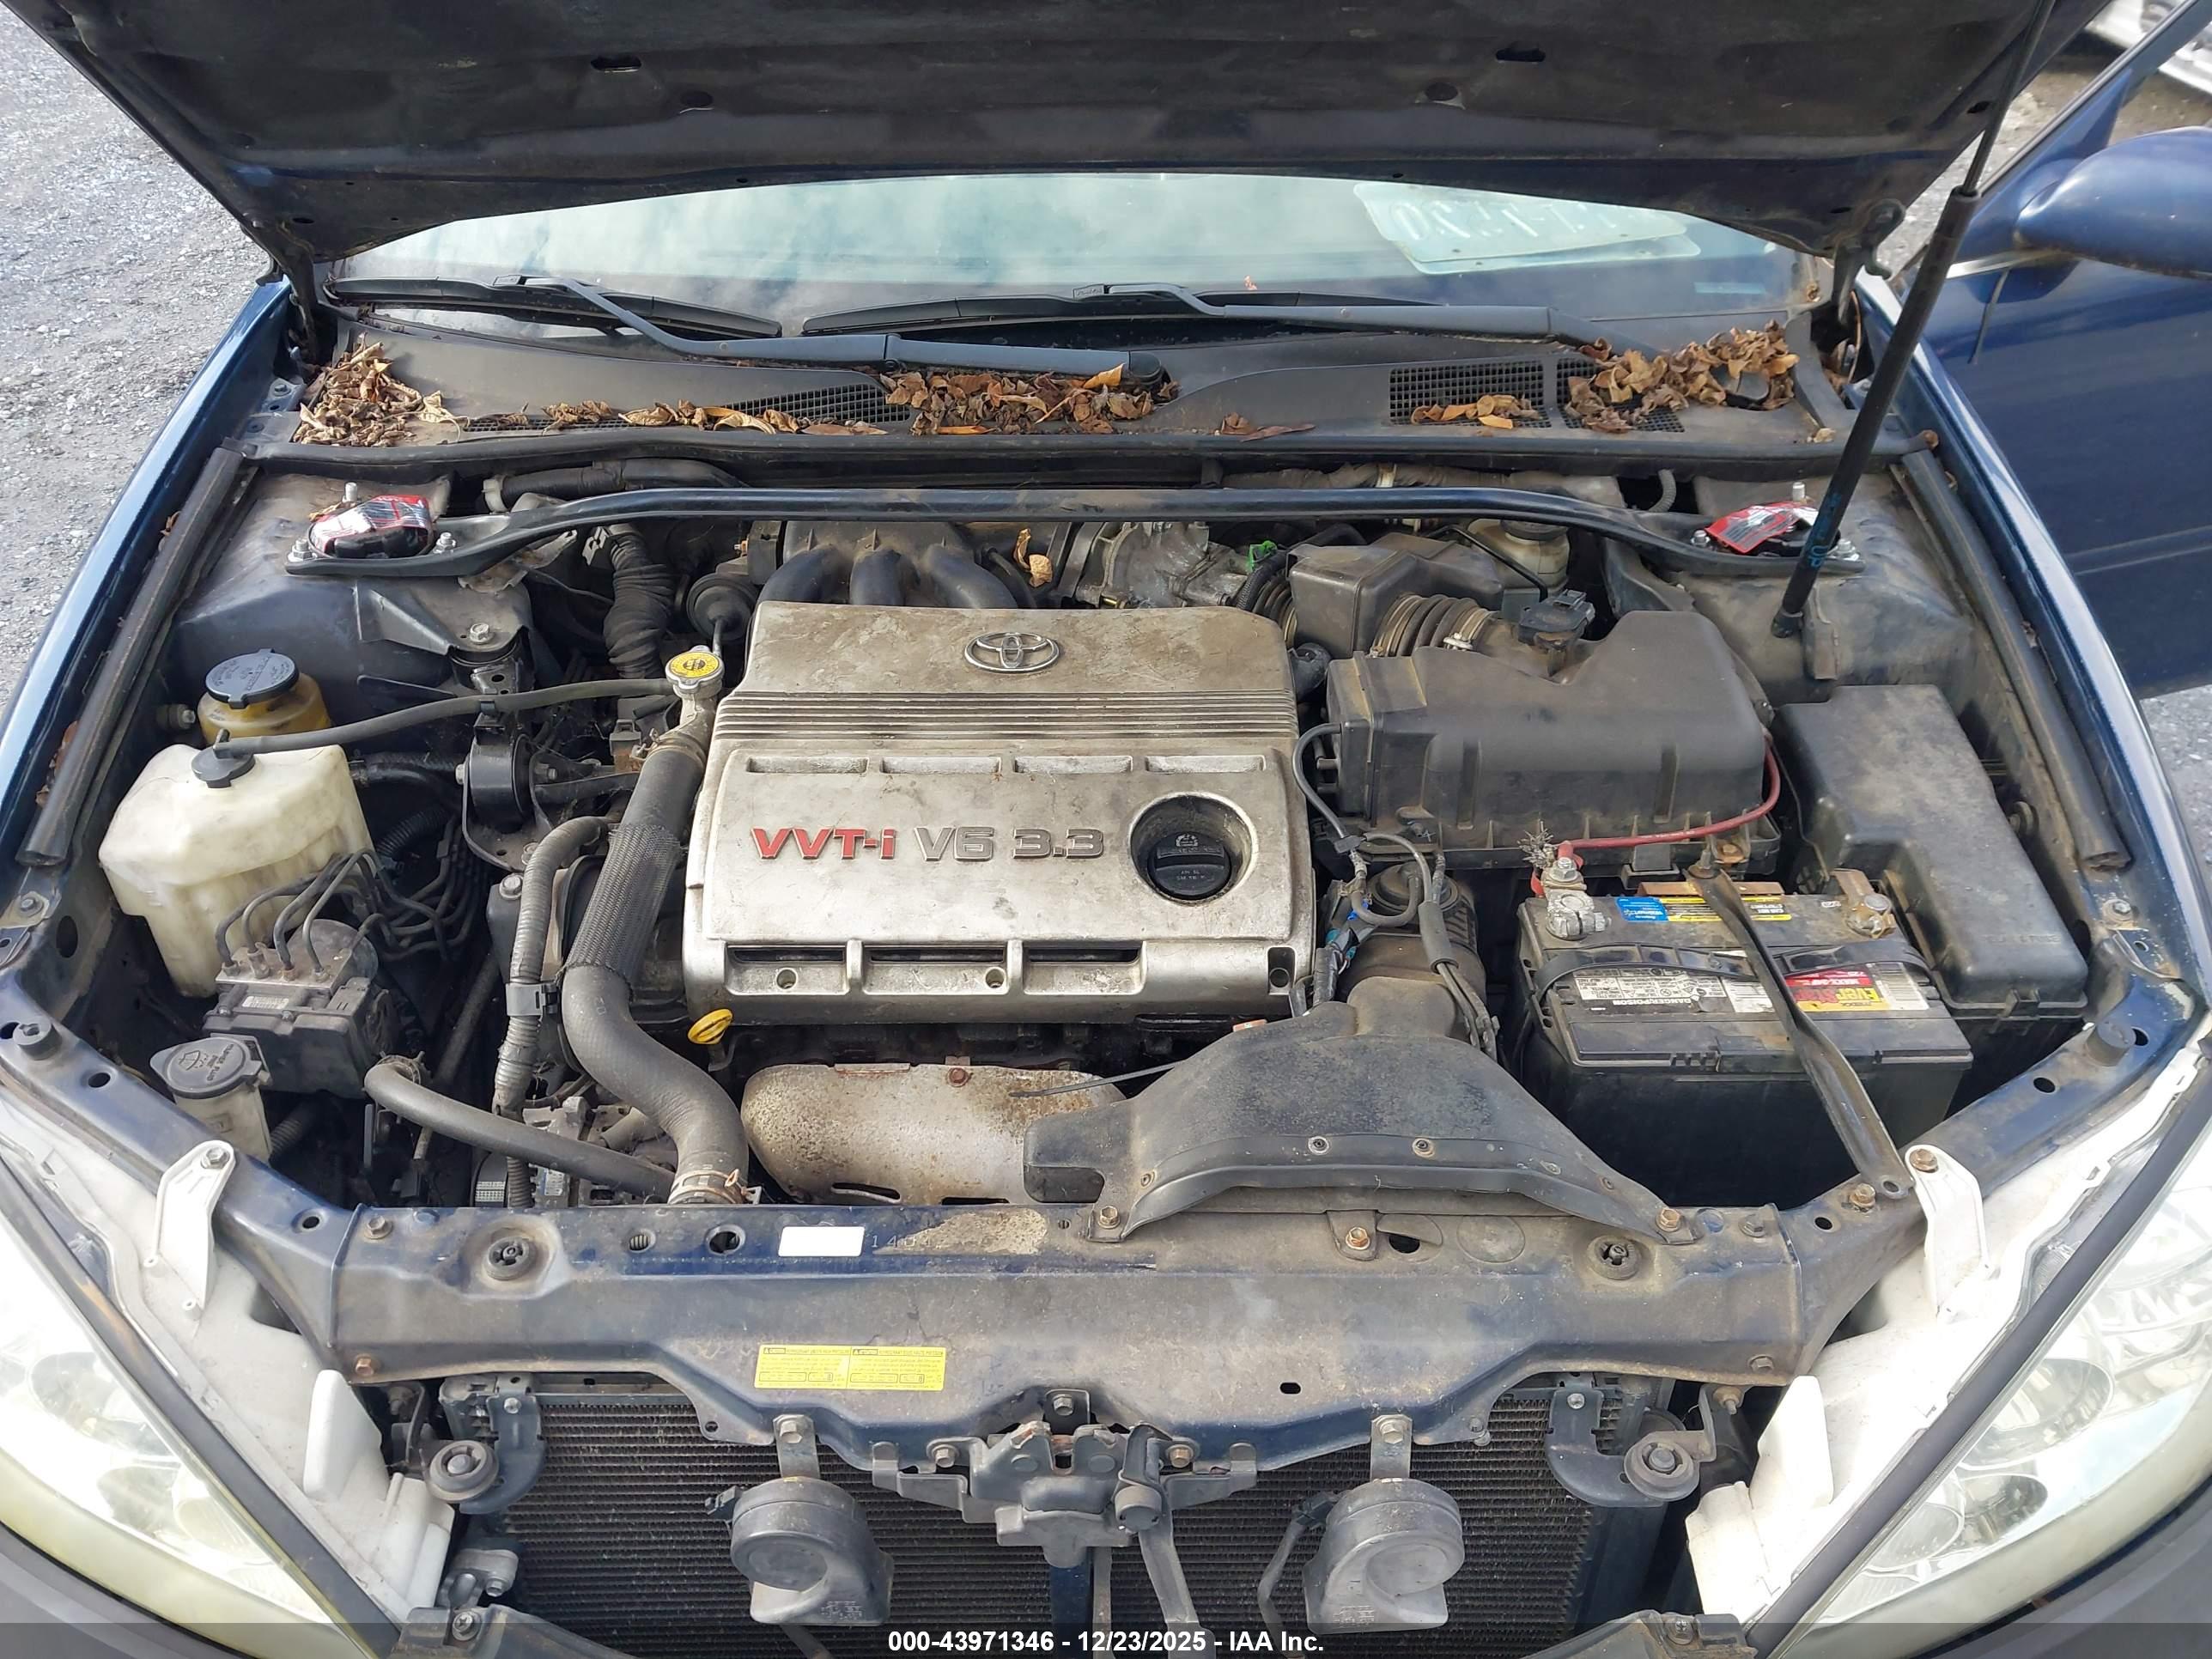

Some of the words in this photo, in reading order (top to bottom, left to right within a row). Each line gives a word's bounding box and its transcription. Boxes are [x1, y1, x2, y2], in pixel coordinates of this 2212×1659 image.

[752, 827, 896, 860] VVT-i
[914, 826, 994, 862] V6
[1013, 827, 1104, 860] 3.3
